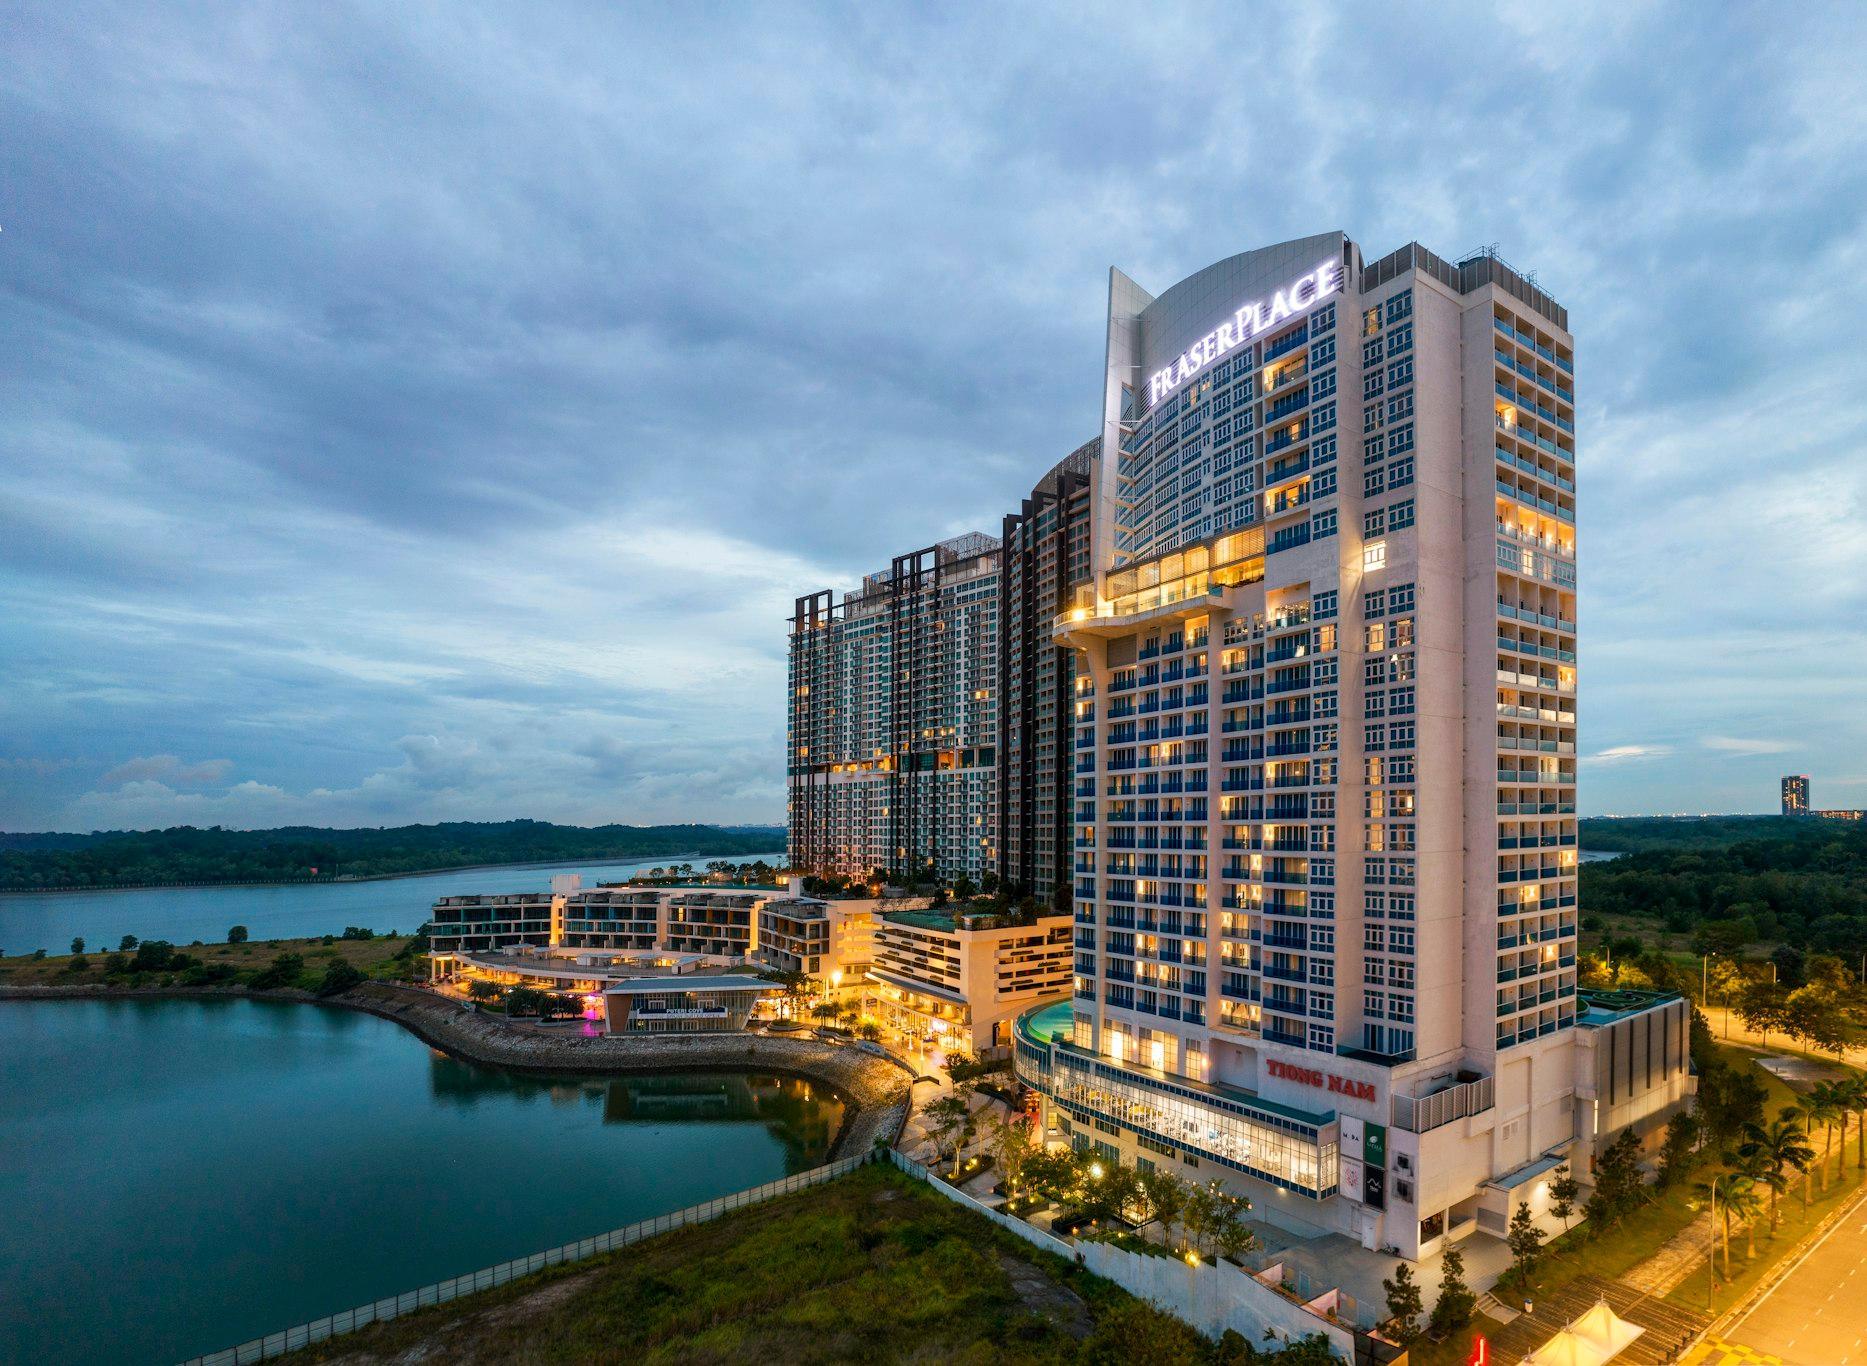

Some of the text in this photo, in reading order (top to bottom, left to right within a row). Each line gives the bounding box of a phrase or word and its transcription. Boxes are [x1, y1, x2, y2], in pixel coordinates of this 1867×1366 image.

[1149, 260, 1337, 407] FRASER PLACE
[1266, 1058, 1376, 1103] TIONG NAM
